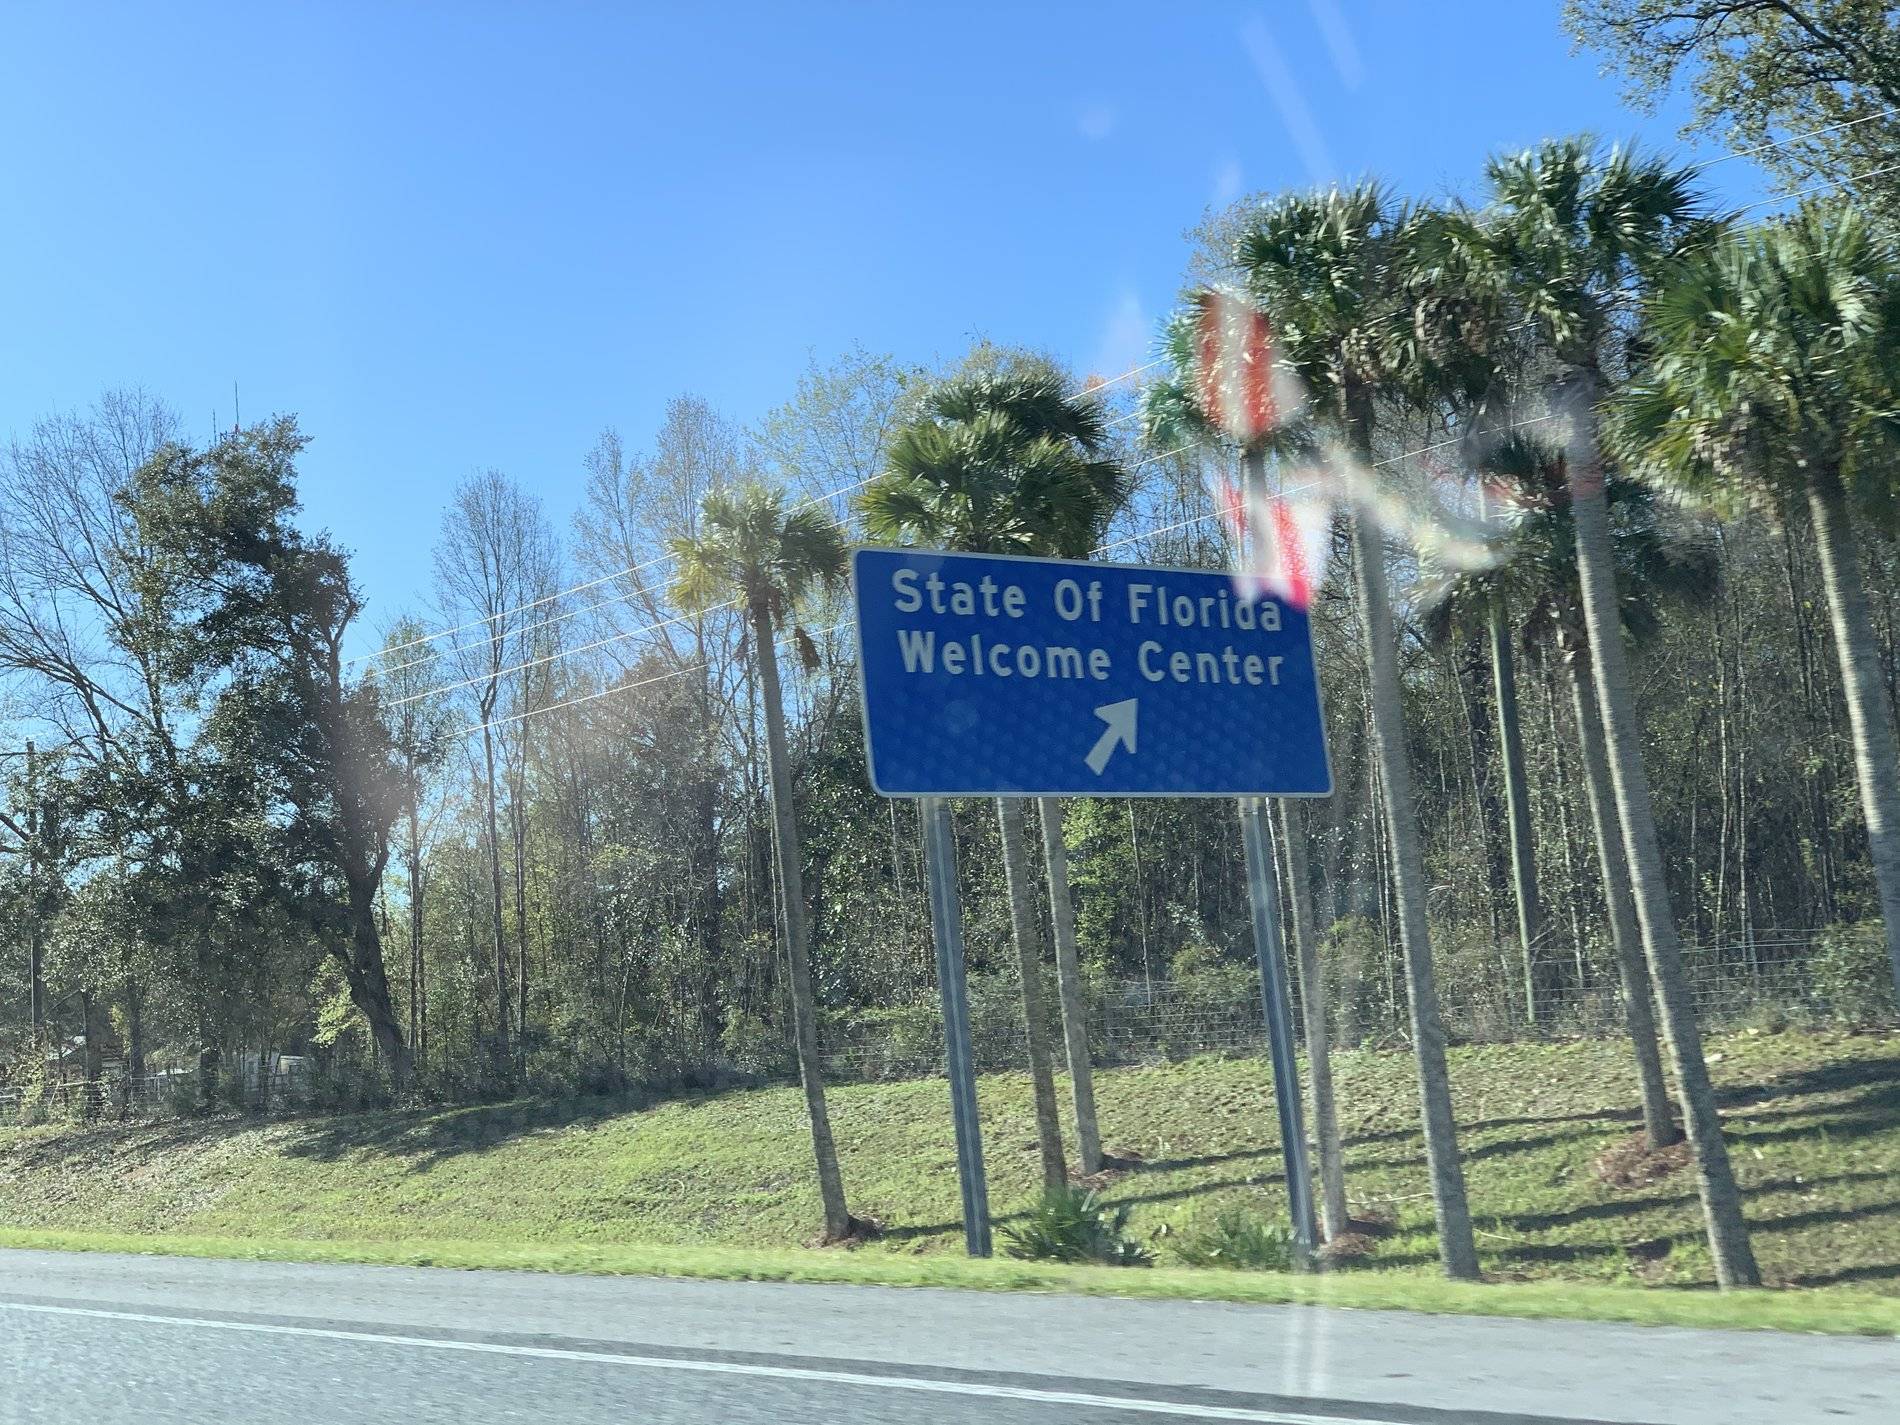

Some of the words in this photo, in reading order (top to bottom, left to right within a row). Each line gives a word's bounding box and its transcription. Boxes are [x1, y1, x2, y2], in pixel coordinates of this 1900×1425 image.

[891, 568, 1027, 618] State
[1054, 578, 1103, 622] Of
[1128, 583, 1283, 632] Florida
[896, 629, 1112, 681] Welcome
[1137, 640, 1285, 686] Center
